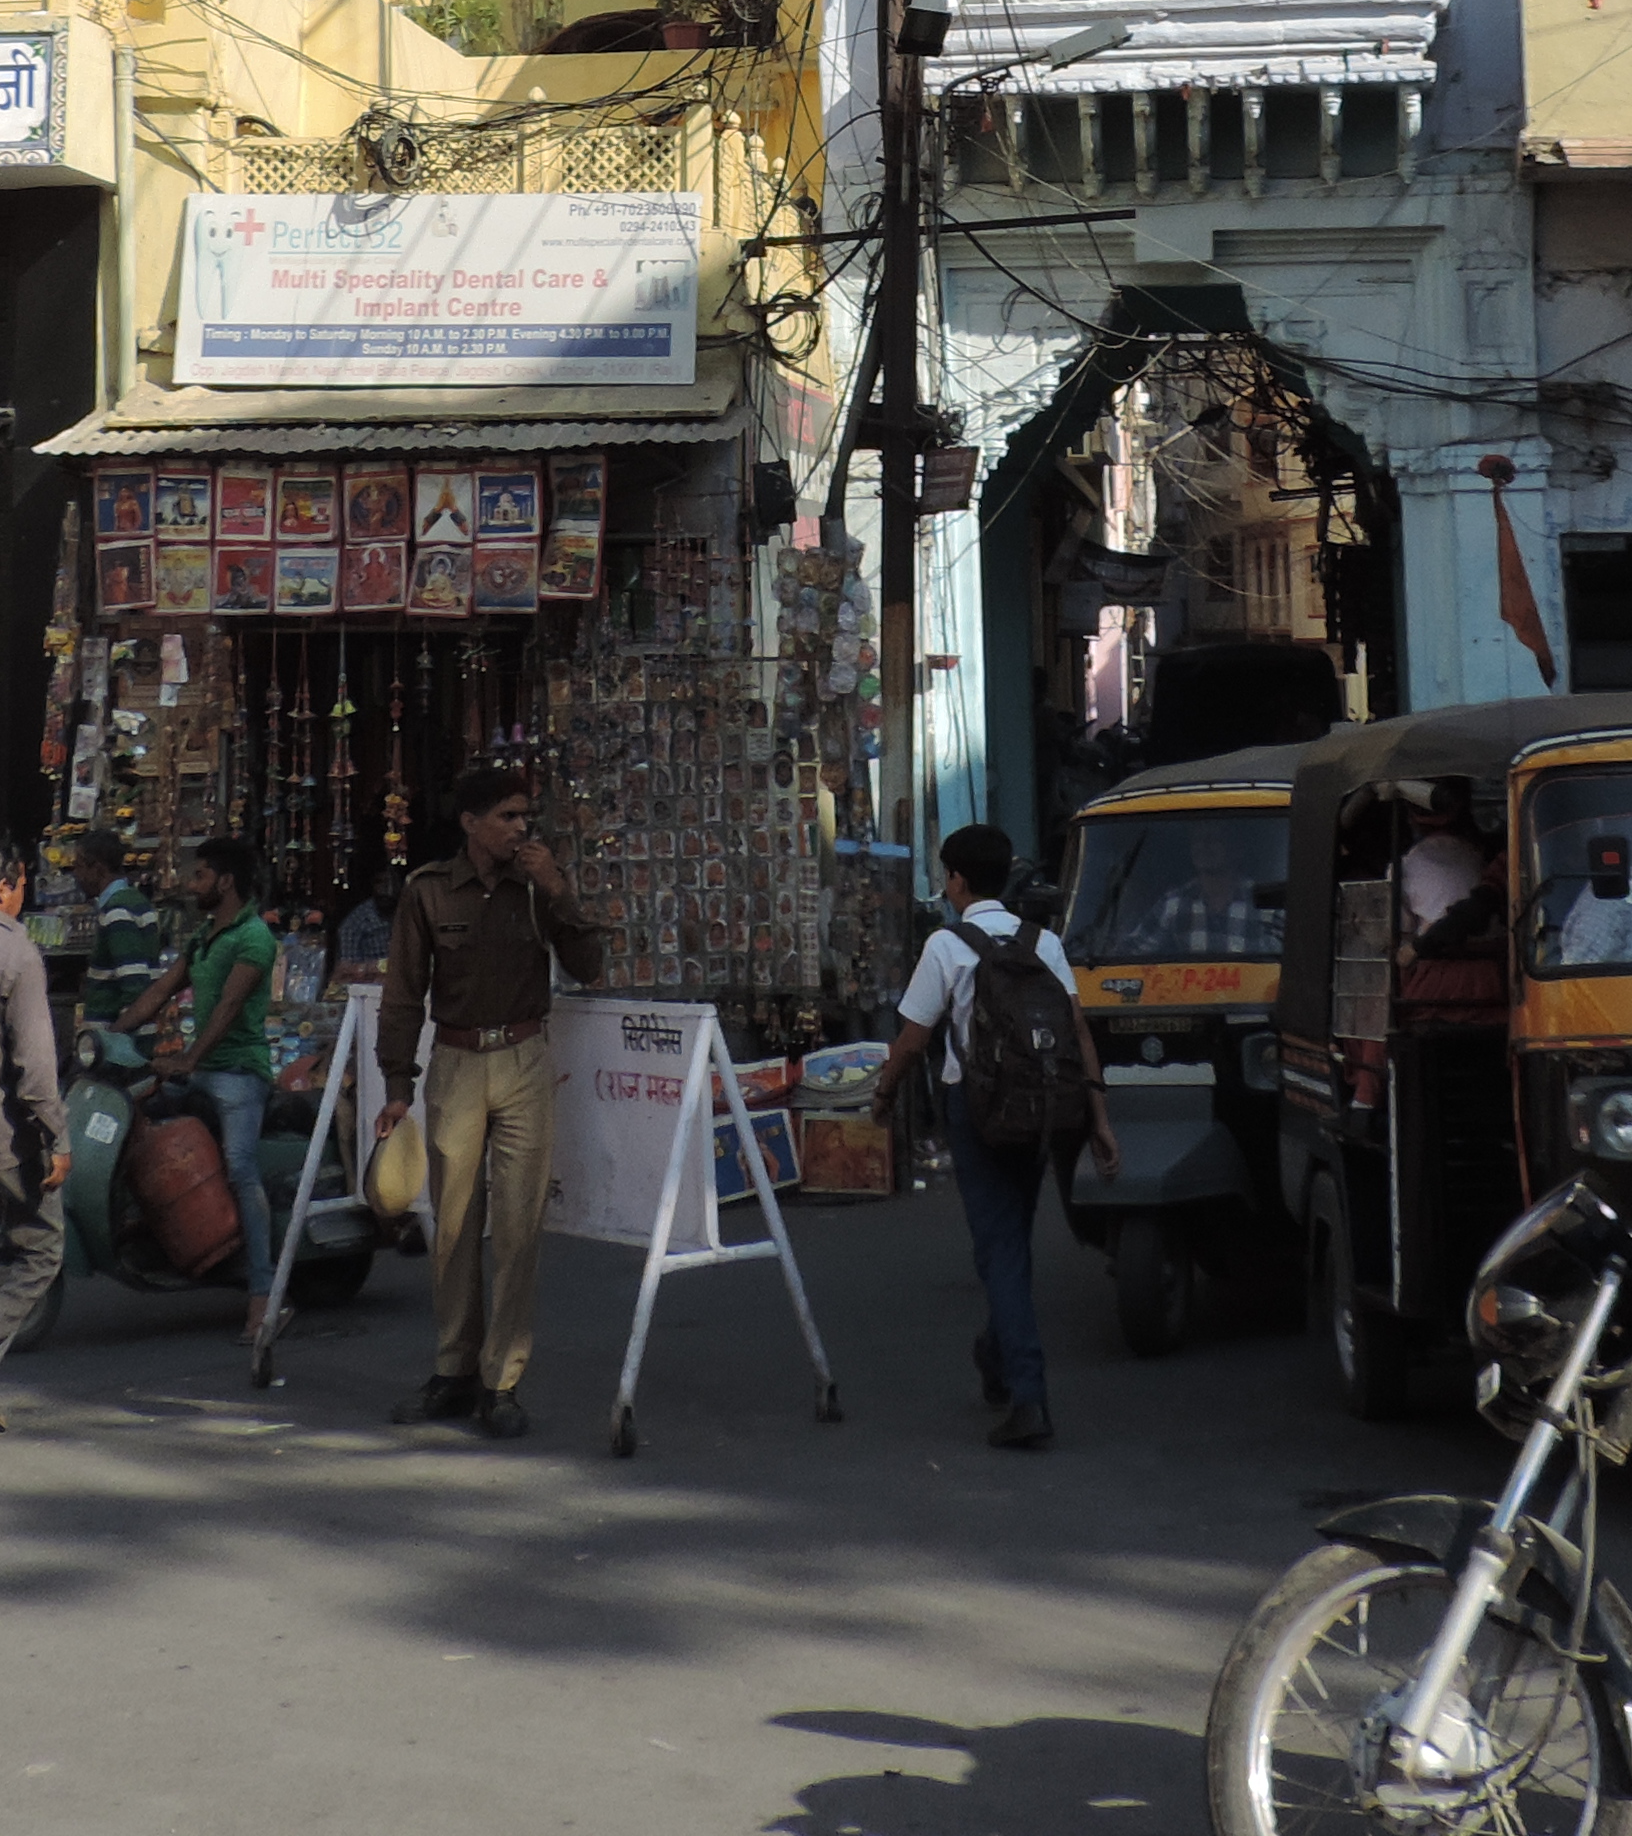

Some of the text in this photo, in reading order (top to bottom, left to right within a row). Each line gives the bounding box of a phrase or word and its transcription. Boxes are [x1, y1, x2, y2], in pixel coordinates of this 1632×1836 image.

[271, 220, 362, 250] Perfect
[271, 268, 610, 295] Multi Speciality Dental Care &
[354, 297, 523, 321] Implant Centre
[250, 329, 293, 342] Monday
[295, 329, 307, 339] to
[309, 329, 358, 342] Saturday
[360, 329, 405, 342] Morning
[449, 329, 461, 339] to
[511, 329, 557, 342] Evening
[362, 343, 403, 356] Sunday
[447, 344, 459, 354] to
